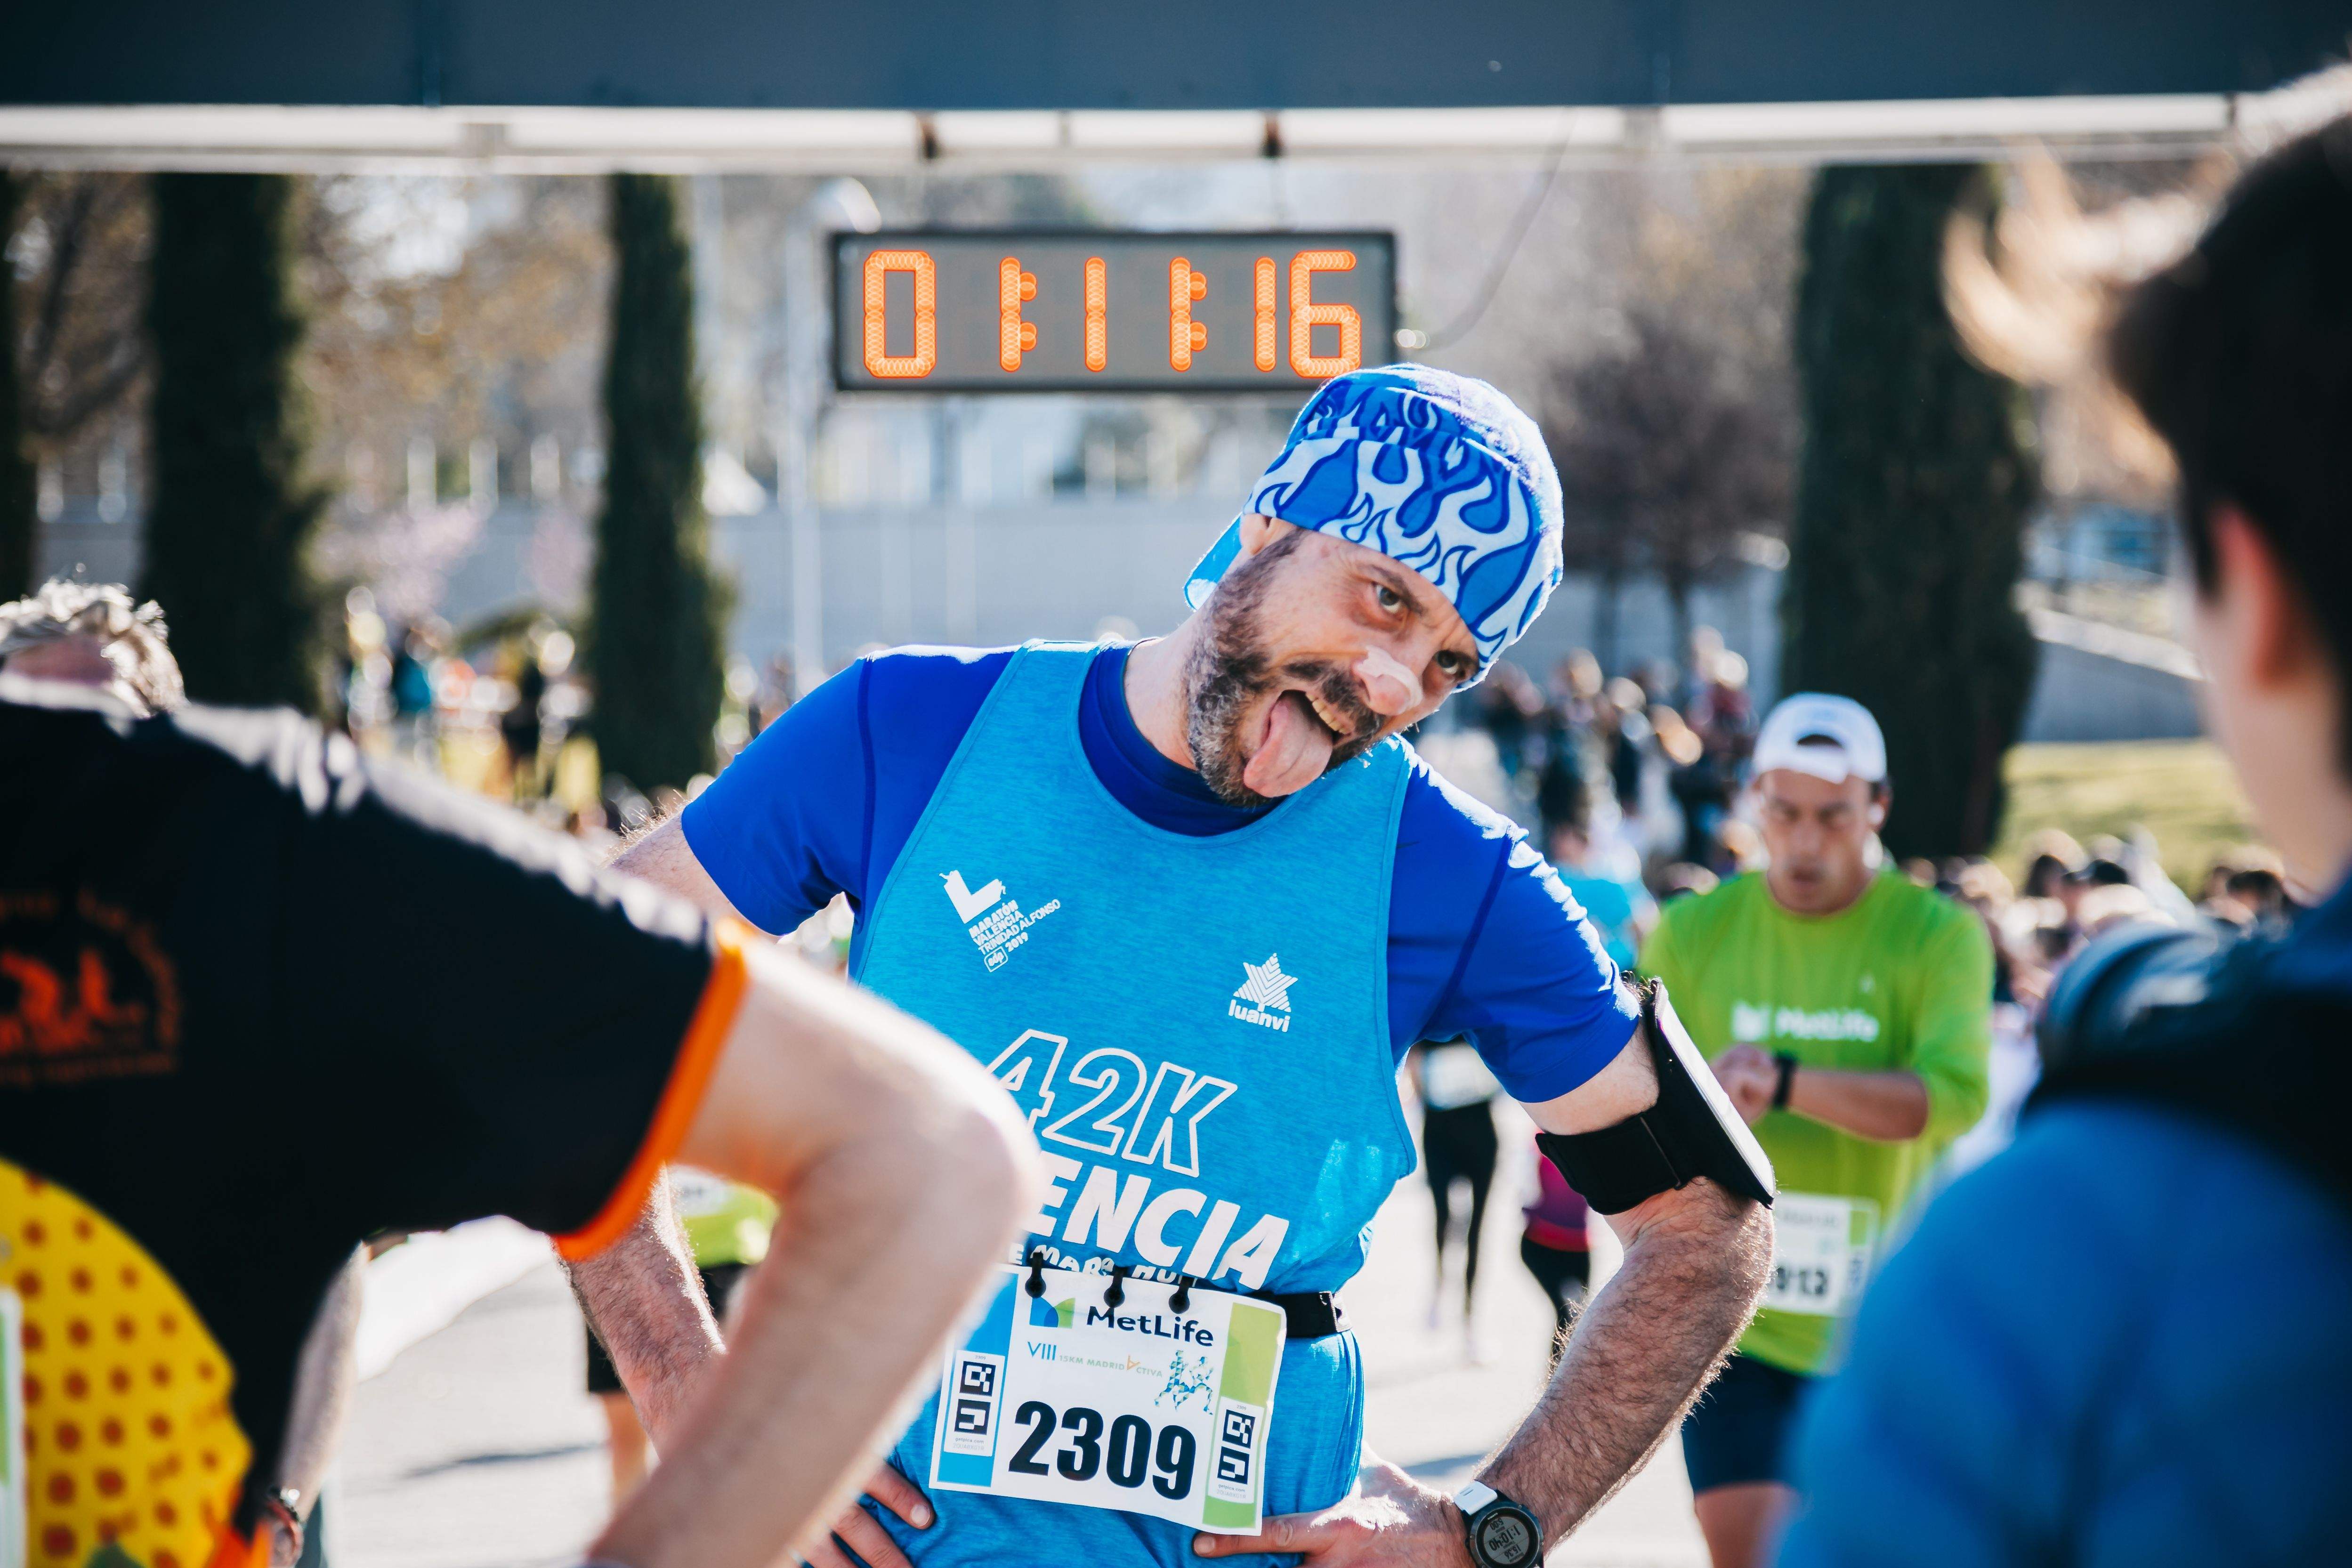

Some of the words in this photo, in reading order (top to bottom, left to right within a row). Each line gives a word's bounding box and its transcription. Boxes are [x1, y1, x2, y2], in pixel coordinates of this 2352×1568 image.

[969, 900, 1018, 938] MARATÓN
[973, 911, 1024, 946] VALENCIA
[978, 924, 1019, 955] TRINIDAD
[1019, 899, 1060, 930] ALFONSO
[1005, 932, 1028, 952] 2019
[1228, 999, 1291, 1033] luanvi
[985, 1029, 1238, 1178] 42K
[1086, 1306, 1213, 1347] MetLife
[1027, 1341, 1057, 1361] VIII
[1059, 1355, 1083, 1365] 15KM
[1087, 1359, 1124, 1371] MADRID
[1008, 1401, 1196, 1500] 2309
[1488, 1525, 1521, 1551] 1:10:40
